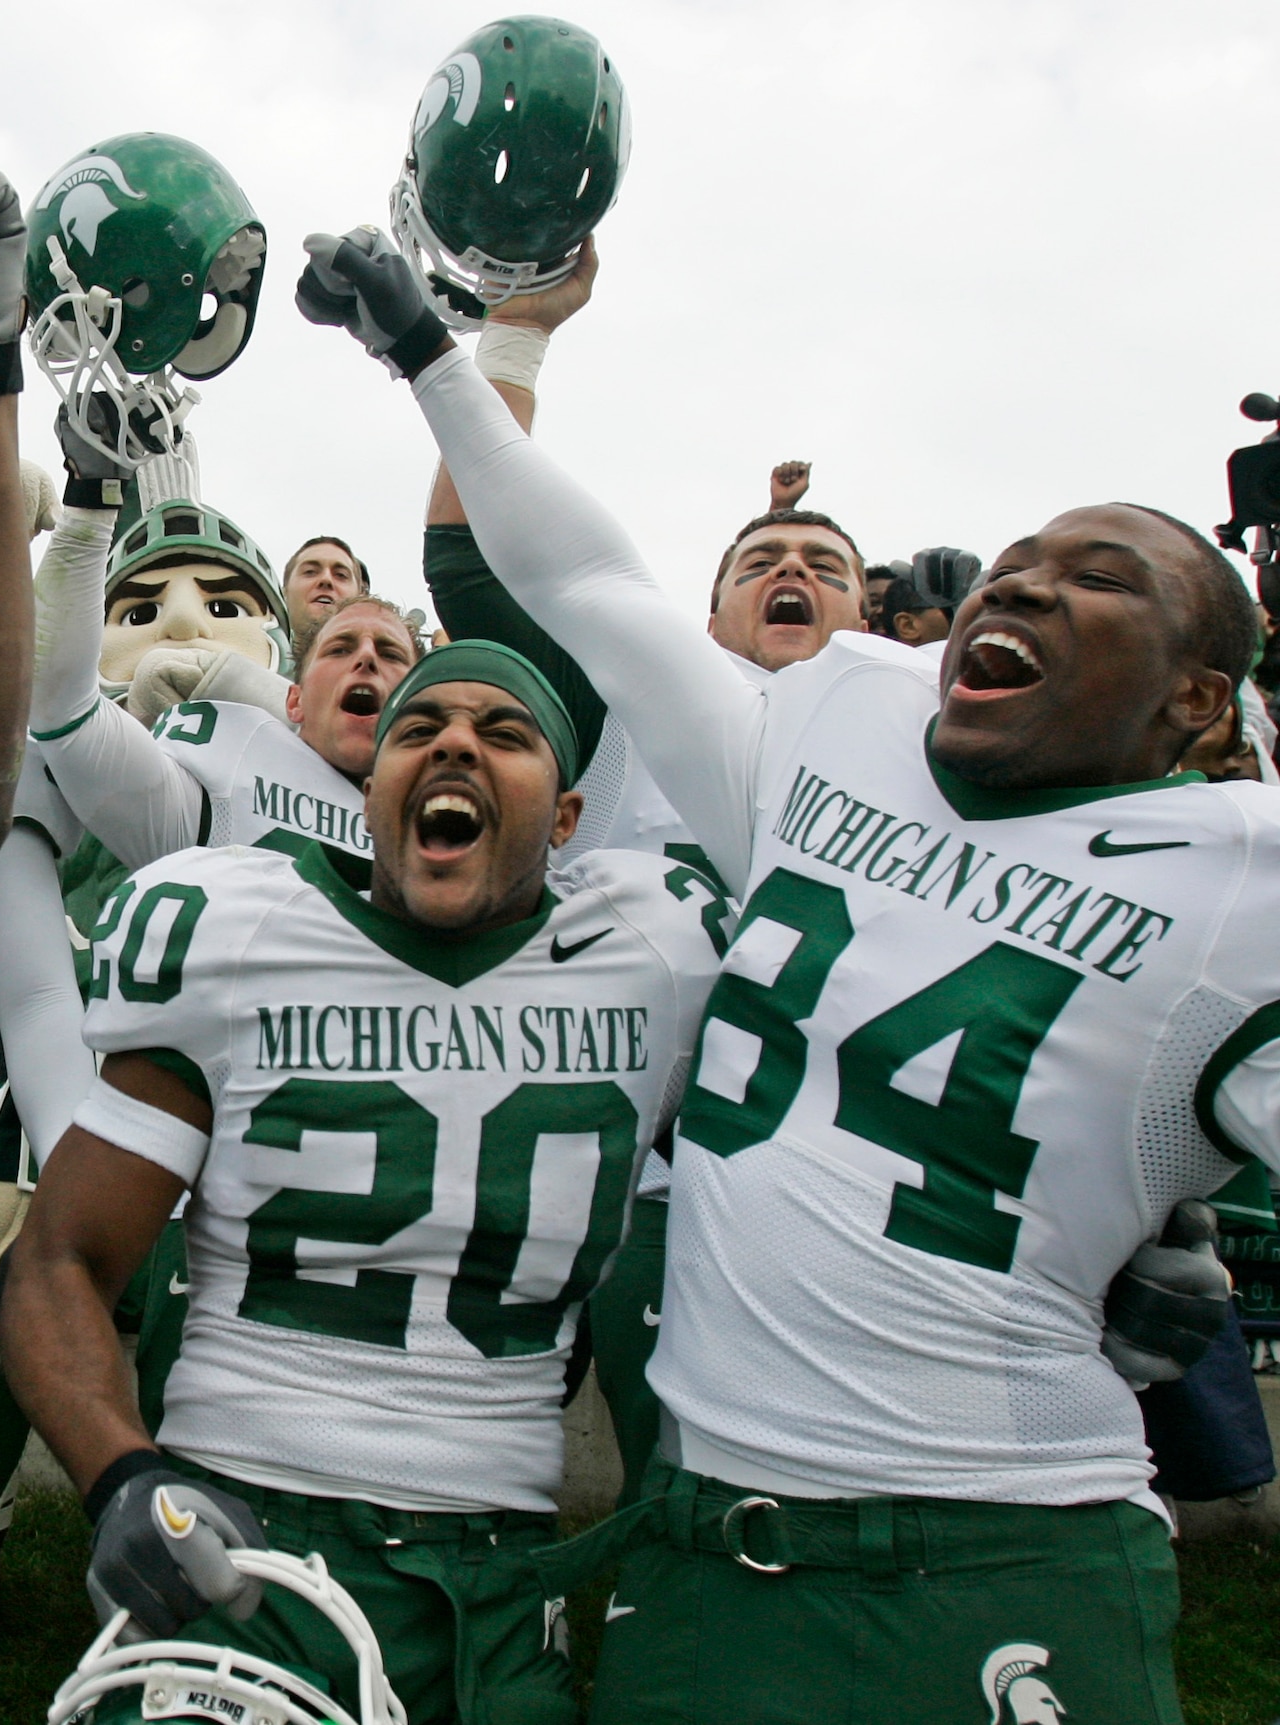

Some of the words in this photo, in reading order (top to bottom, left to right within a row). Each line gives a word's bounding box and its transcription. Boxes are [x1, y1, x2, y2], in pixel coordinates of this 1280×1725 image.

[252, 775, 375, 851] MICHIG
[772, 765, 995, 912] MICHIGAN
[969, 862, 1174, 984] STATE
[255, 1004, 507, 1073] MICHIGAN
[520, 1006, 649, 1073] STATE
[678, 866, 1087, 1275] 84
[237, 1078, 639, 1360] 20
